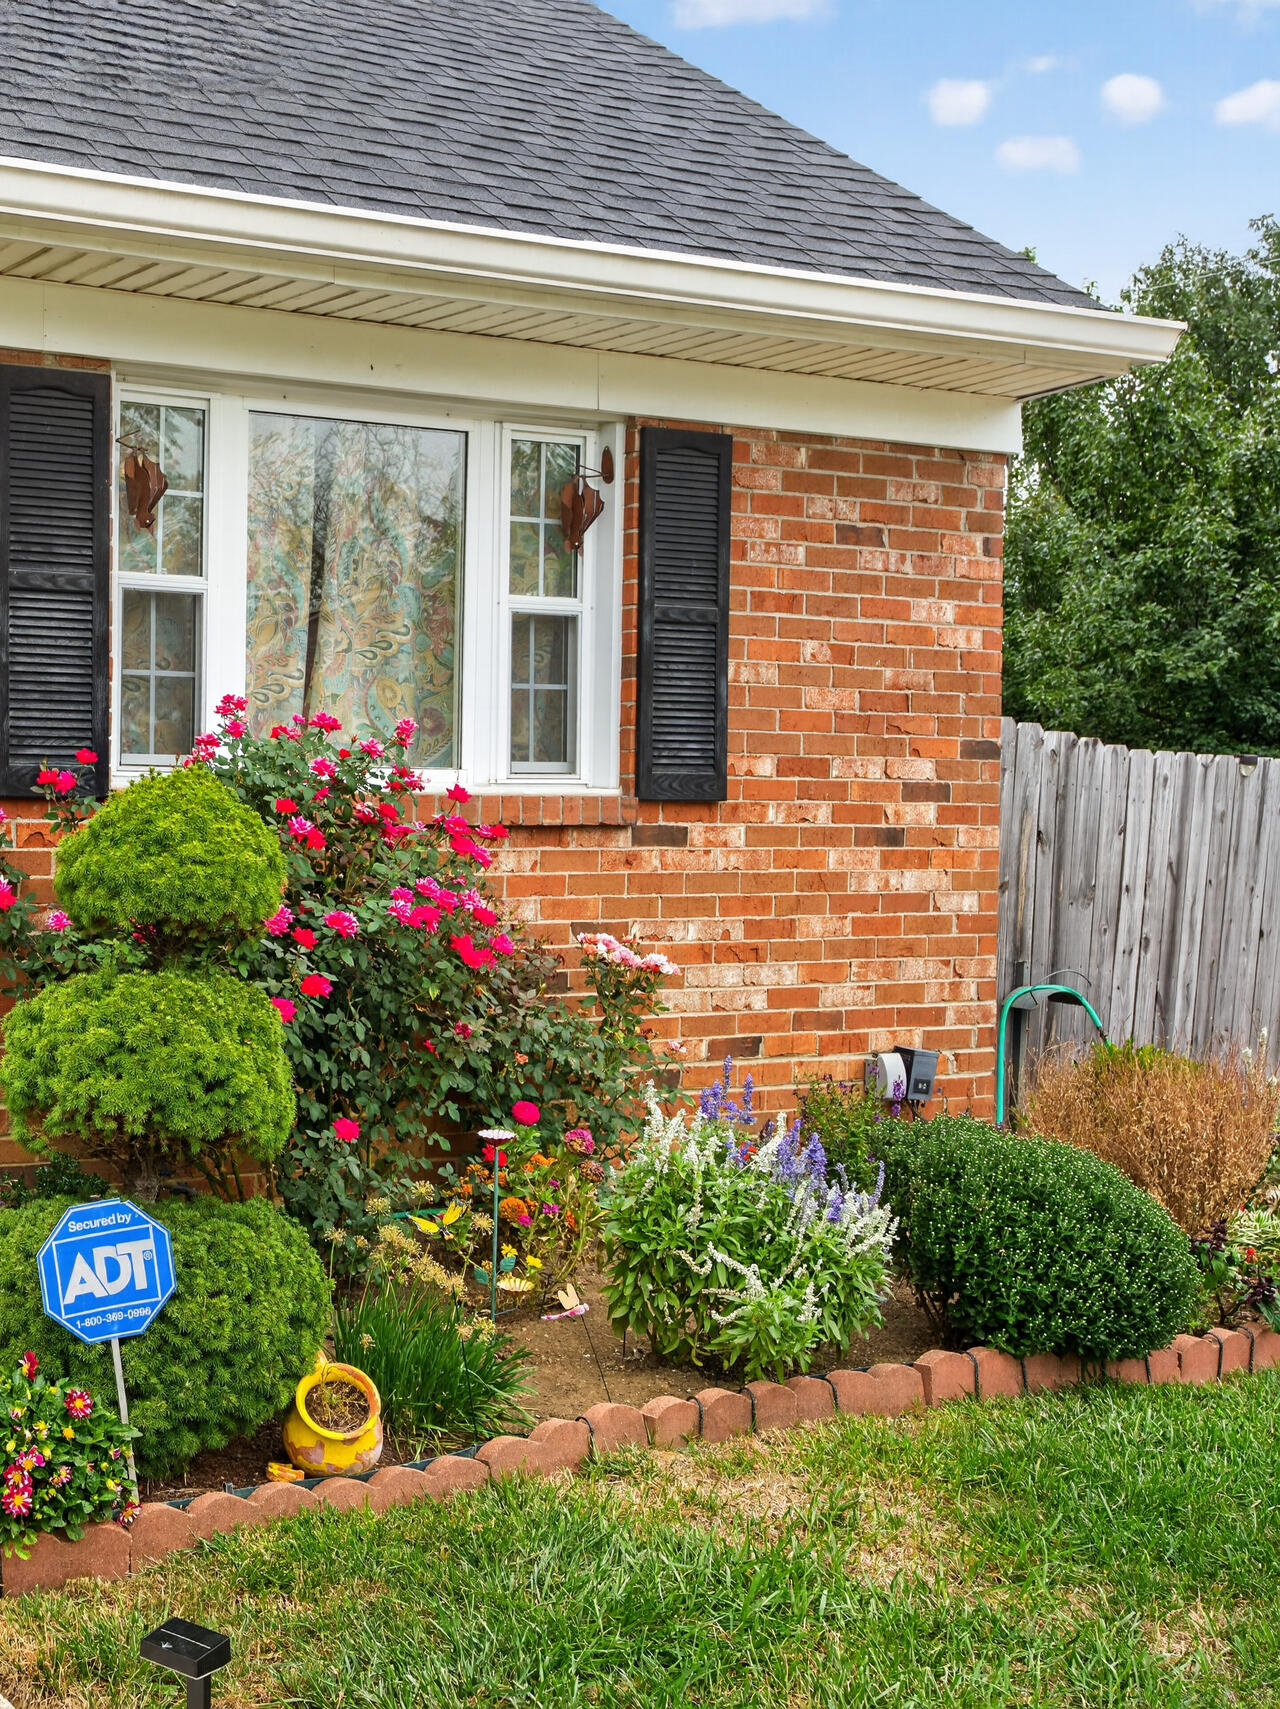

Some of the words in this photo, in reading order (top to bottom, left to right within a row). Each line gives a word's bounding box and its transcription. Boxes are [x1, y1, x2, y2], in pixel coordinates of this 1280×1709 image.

[68, 1213, 116, 1232] Secured
[117, 1212, 132, 1224] by
[63, 1239, 153, 1305] ADT
